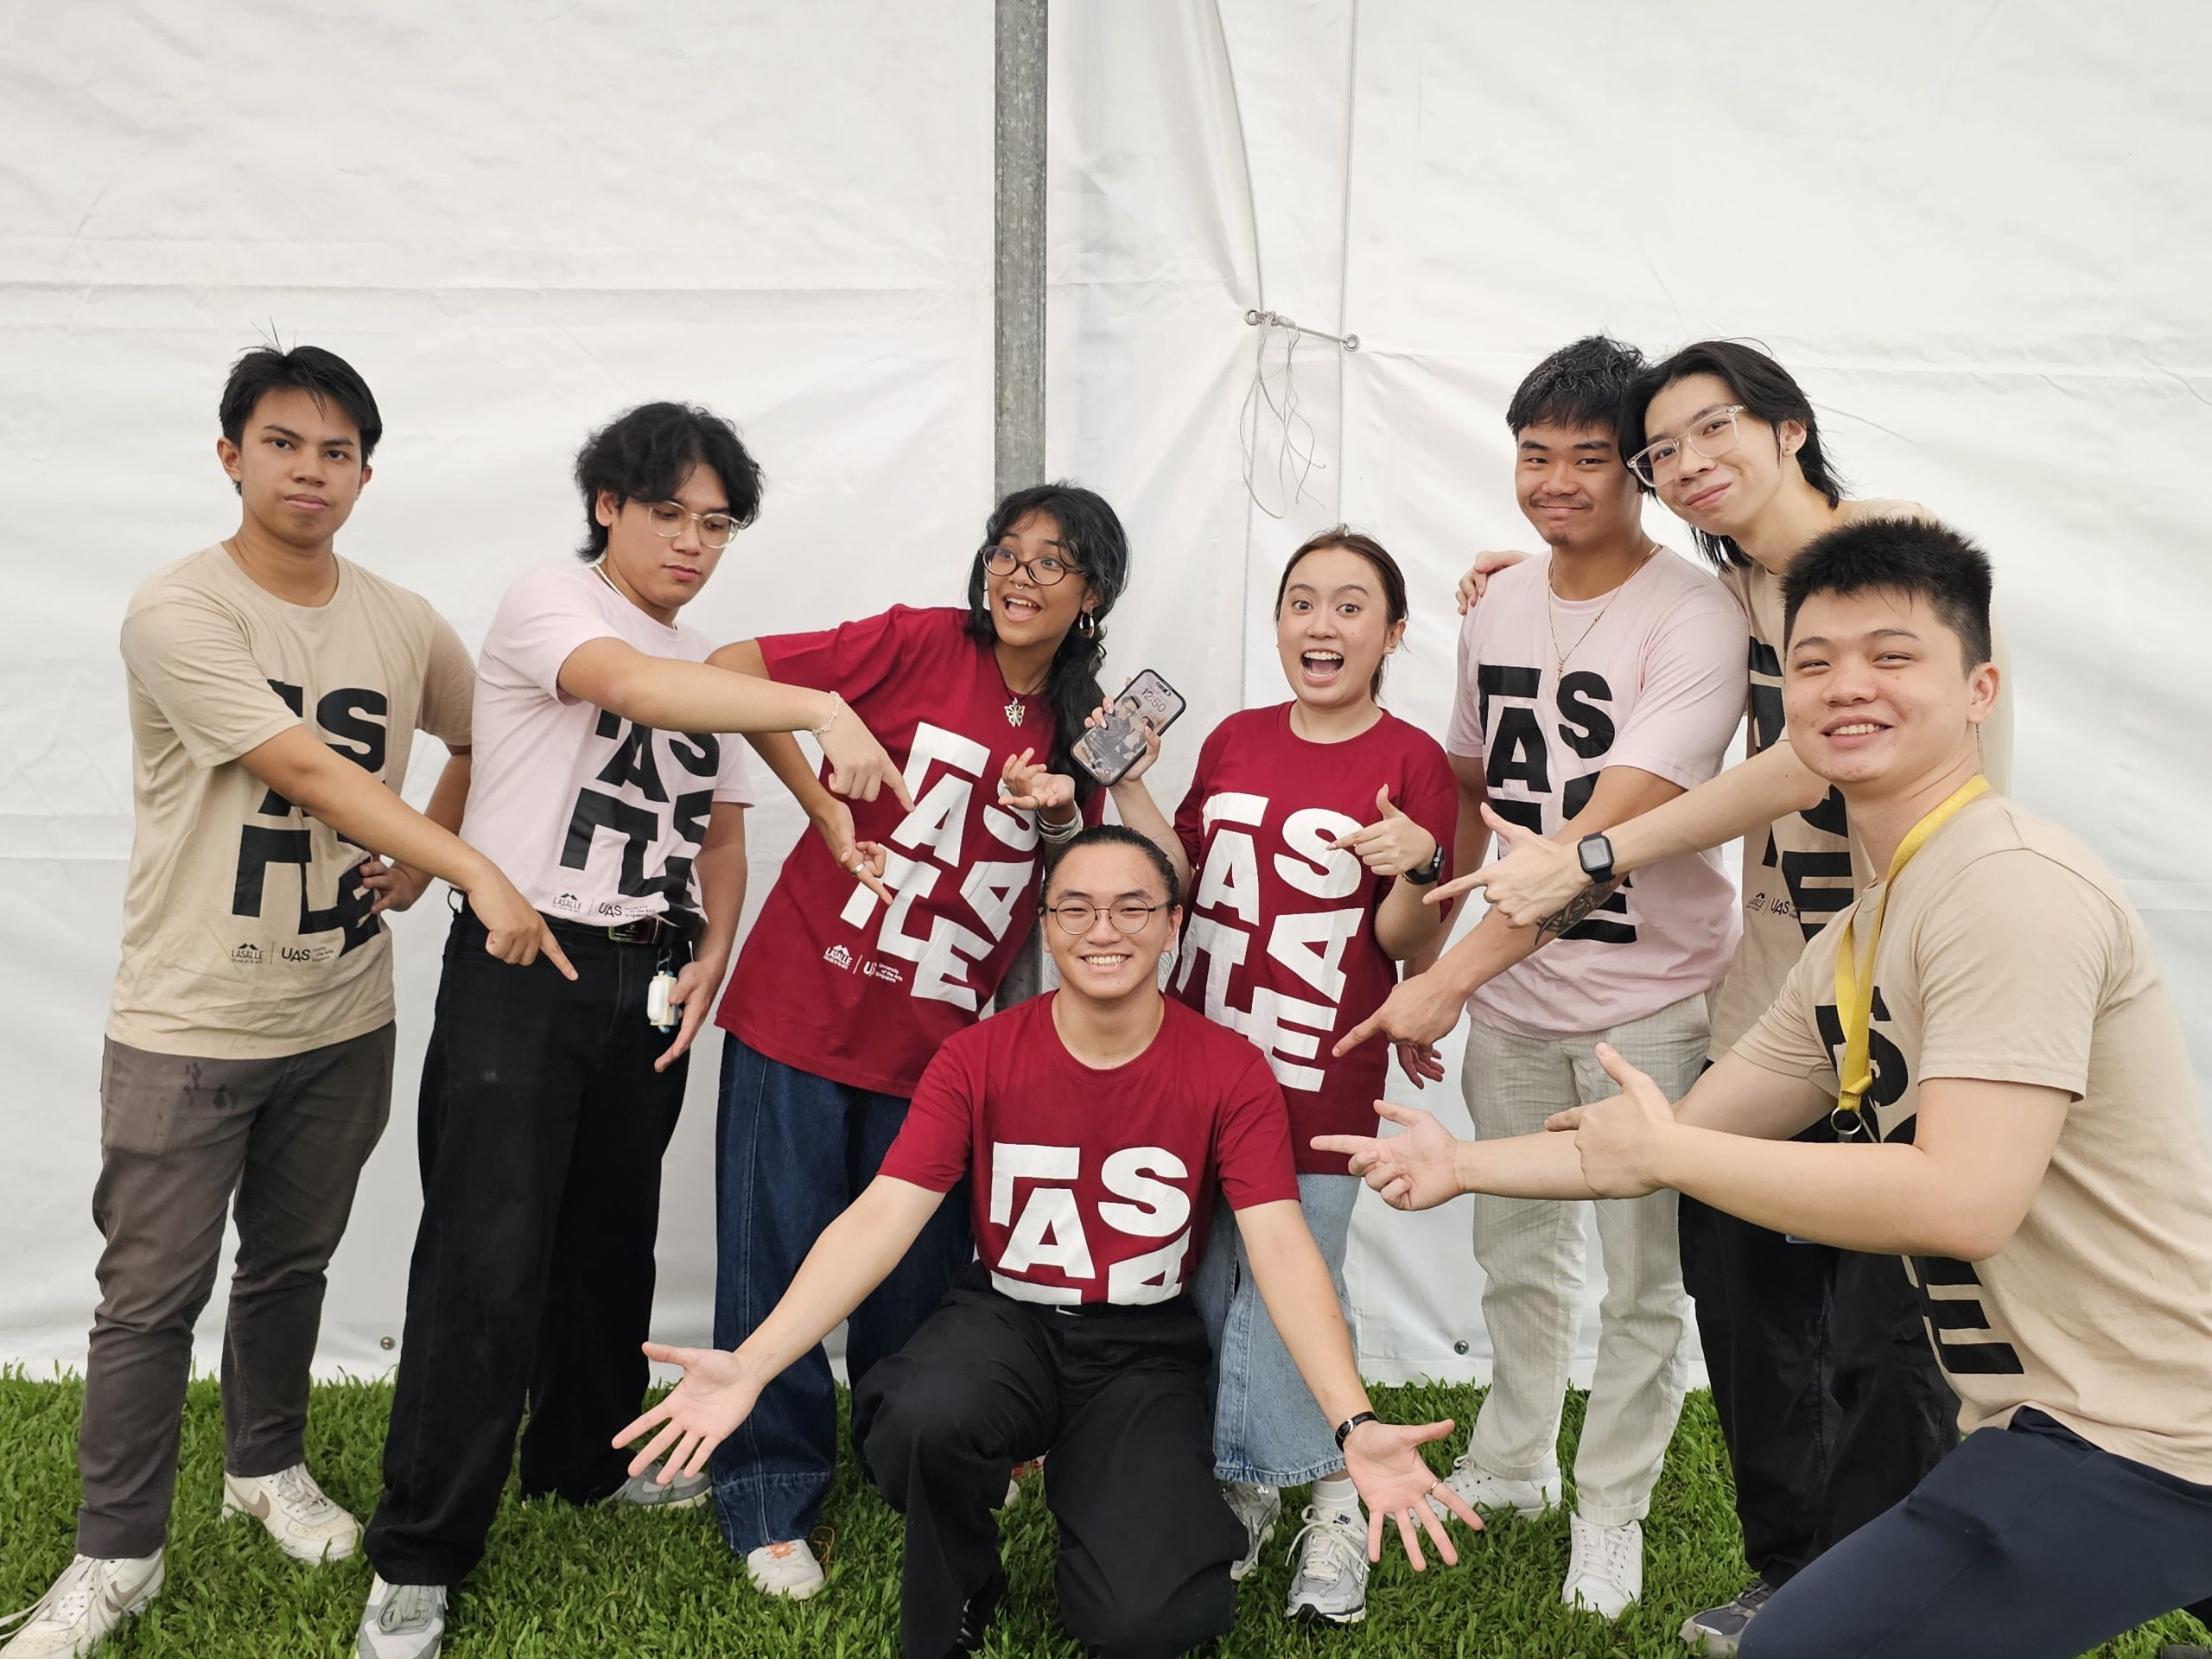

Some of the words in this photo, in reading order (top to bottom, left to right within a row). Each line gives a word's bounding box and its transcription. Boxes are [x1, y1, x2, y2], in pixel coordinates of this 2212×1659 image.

[1142, 687, 1166, 712] 12:50
[598, 902, 622, 918] UAS
[1770, 898, 1789, 915] UAS
[231, 949, 264, 959] LASALLE
[281, 947, 310, 962] UAS
[825, 946, 853, 966] LASALLE
